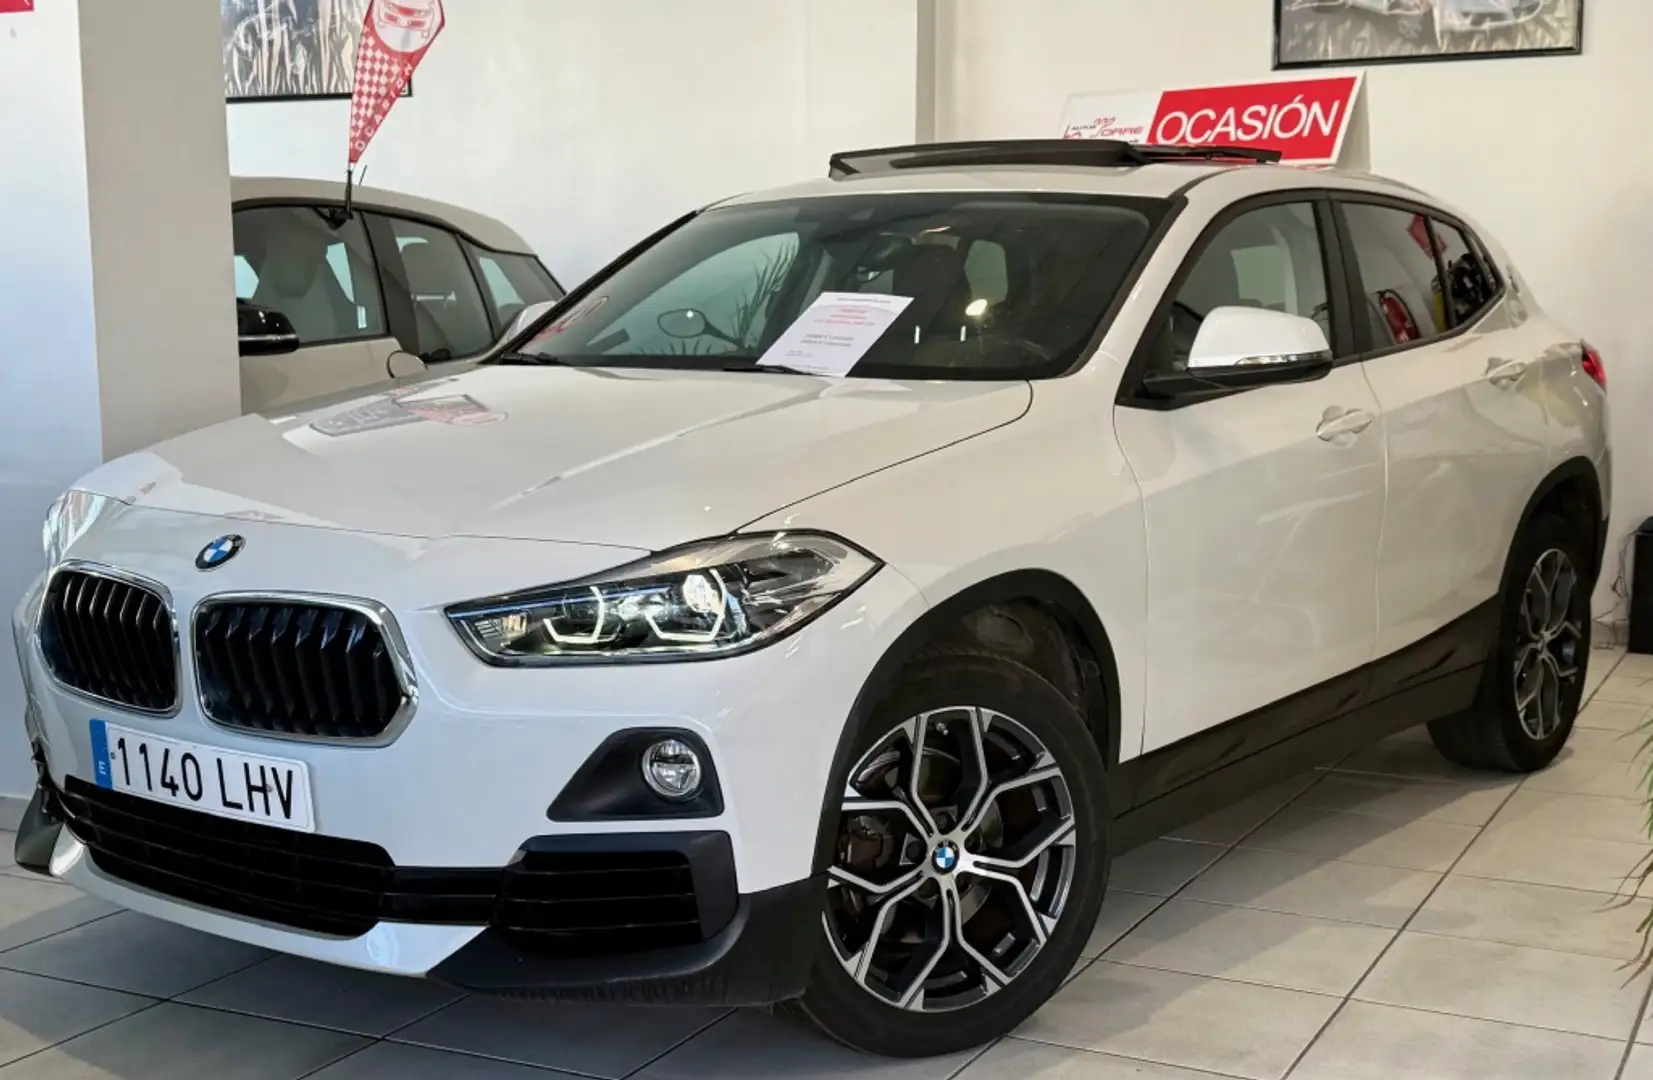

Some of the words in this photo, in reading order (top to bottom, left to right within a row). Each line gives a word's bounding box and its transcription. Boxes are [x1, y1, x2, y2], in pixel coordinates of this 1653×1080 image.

[1156, 94, 1340, 145] OCASIÓN
[117, 737, 204, 802] 1140
[216, 757, 293, 820] LHV
